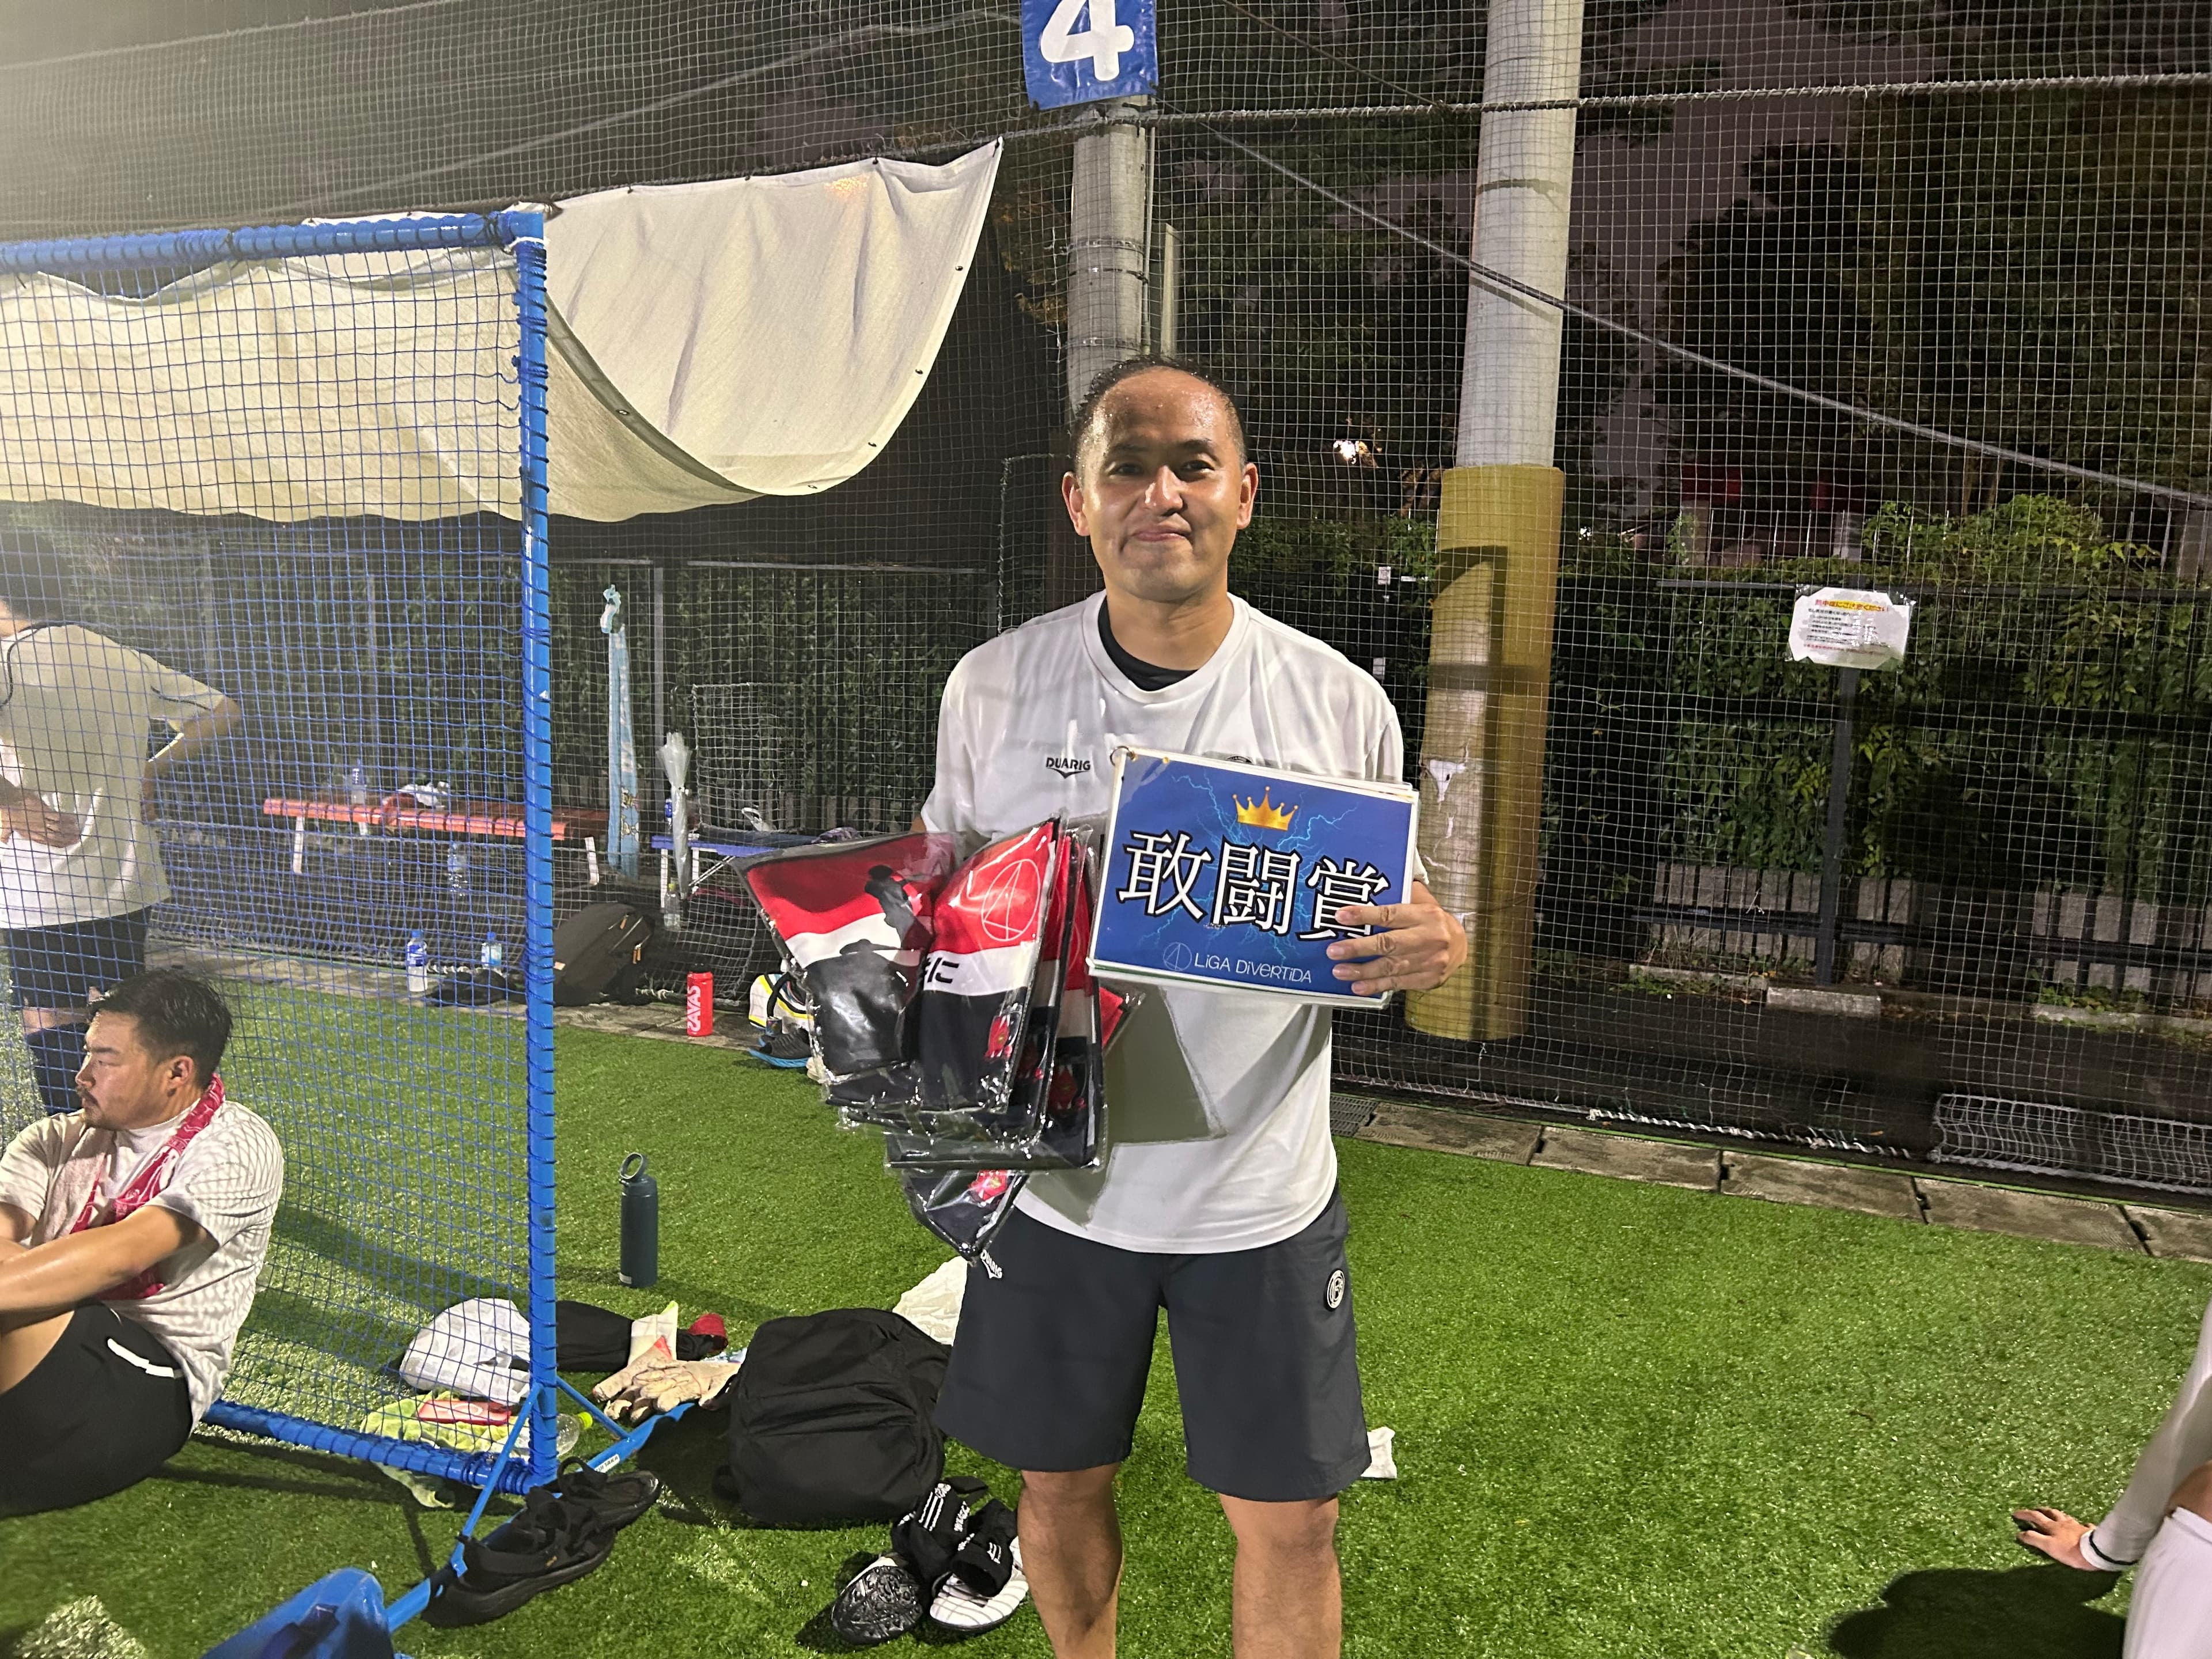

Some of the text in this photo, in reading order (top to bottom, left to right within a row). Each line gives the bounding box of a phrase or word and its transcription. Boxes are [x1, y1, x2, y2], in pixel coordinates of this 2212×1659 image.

[1040, 0, 1134, 81] 4
[1046, 757, 1091, 771] DUARIG
[1116, 830, 1389, 941] 敢闘賞
[687, 985, 701, 1032] SAVAS
[980, 1249, 1003, 1278] DUARIG
